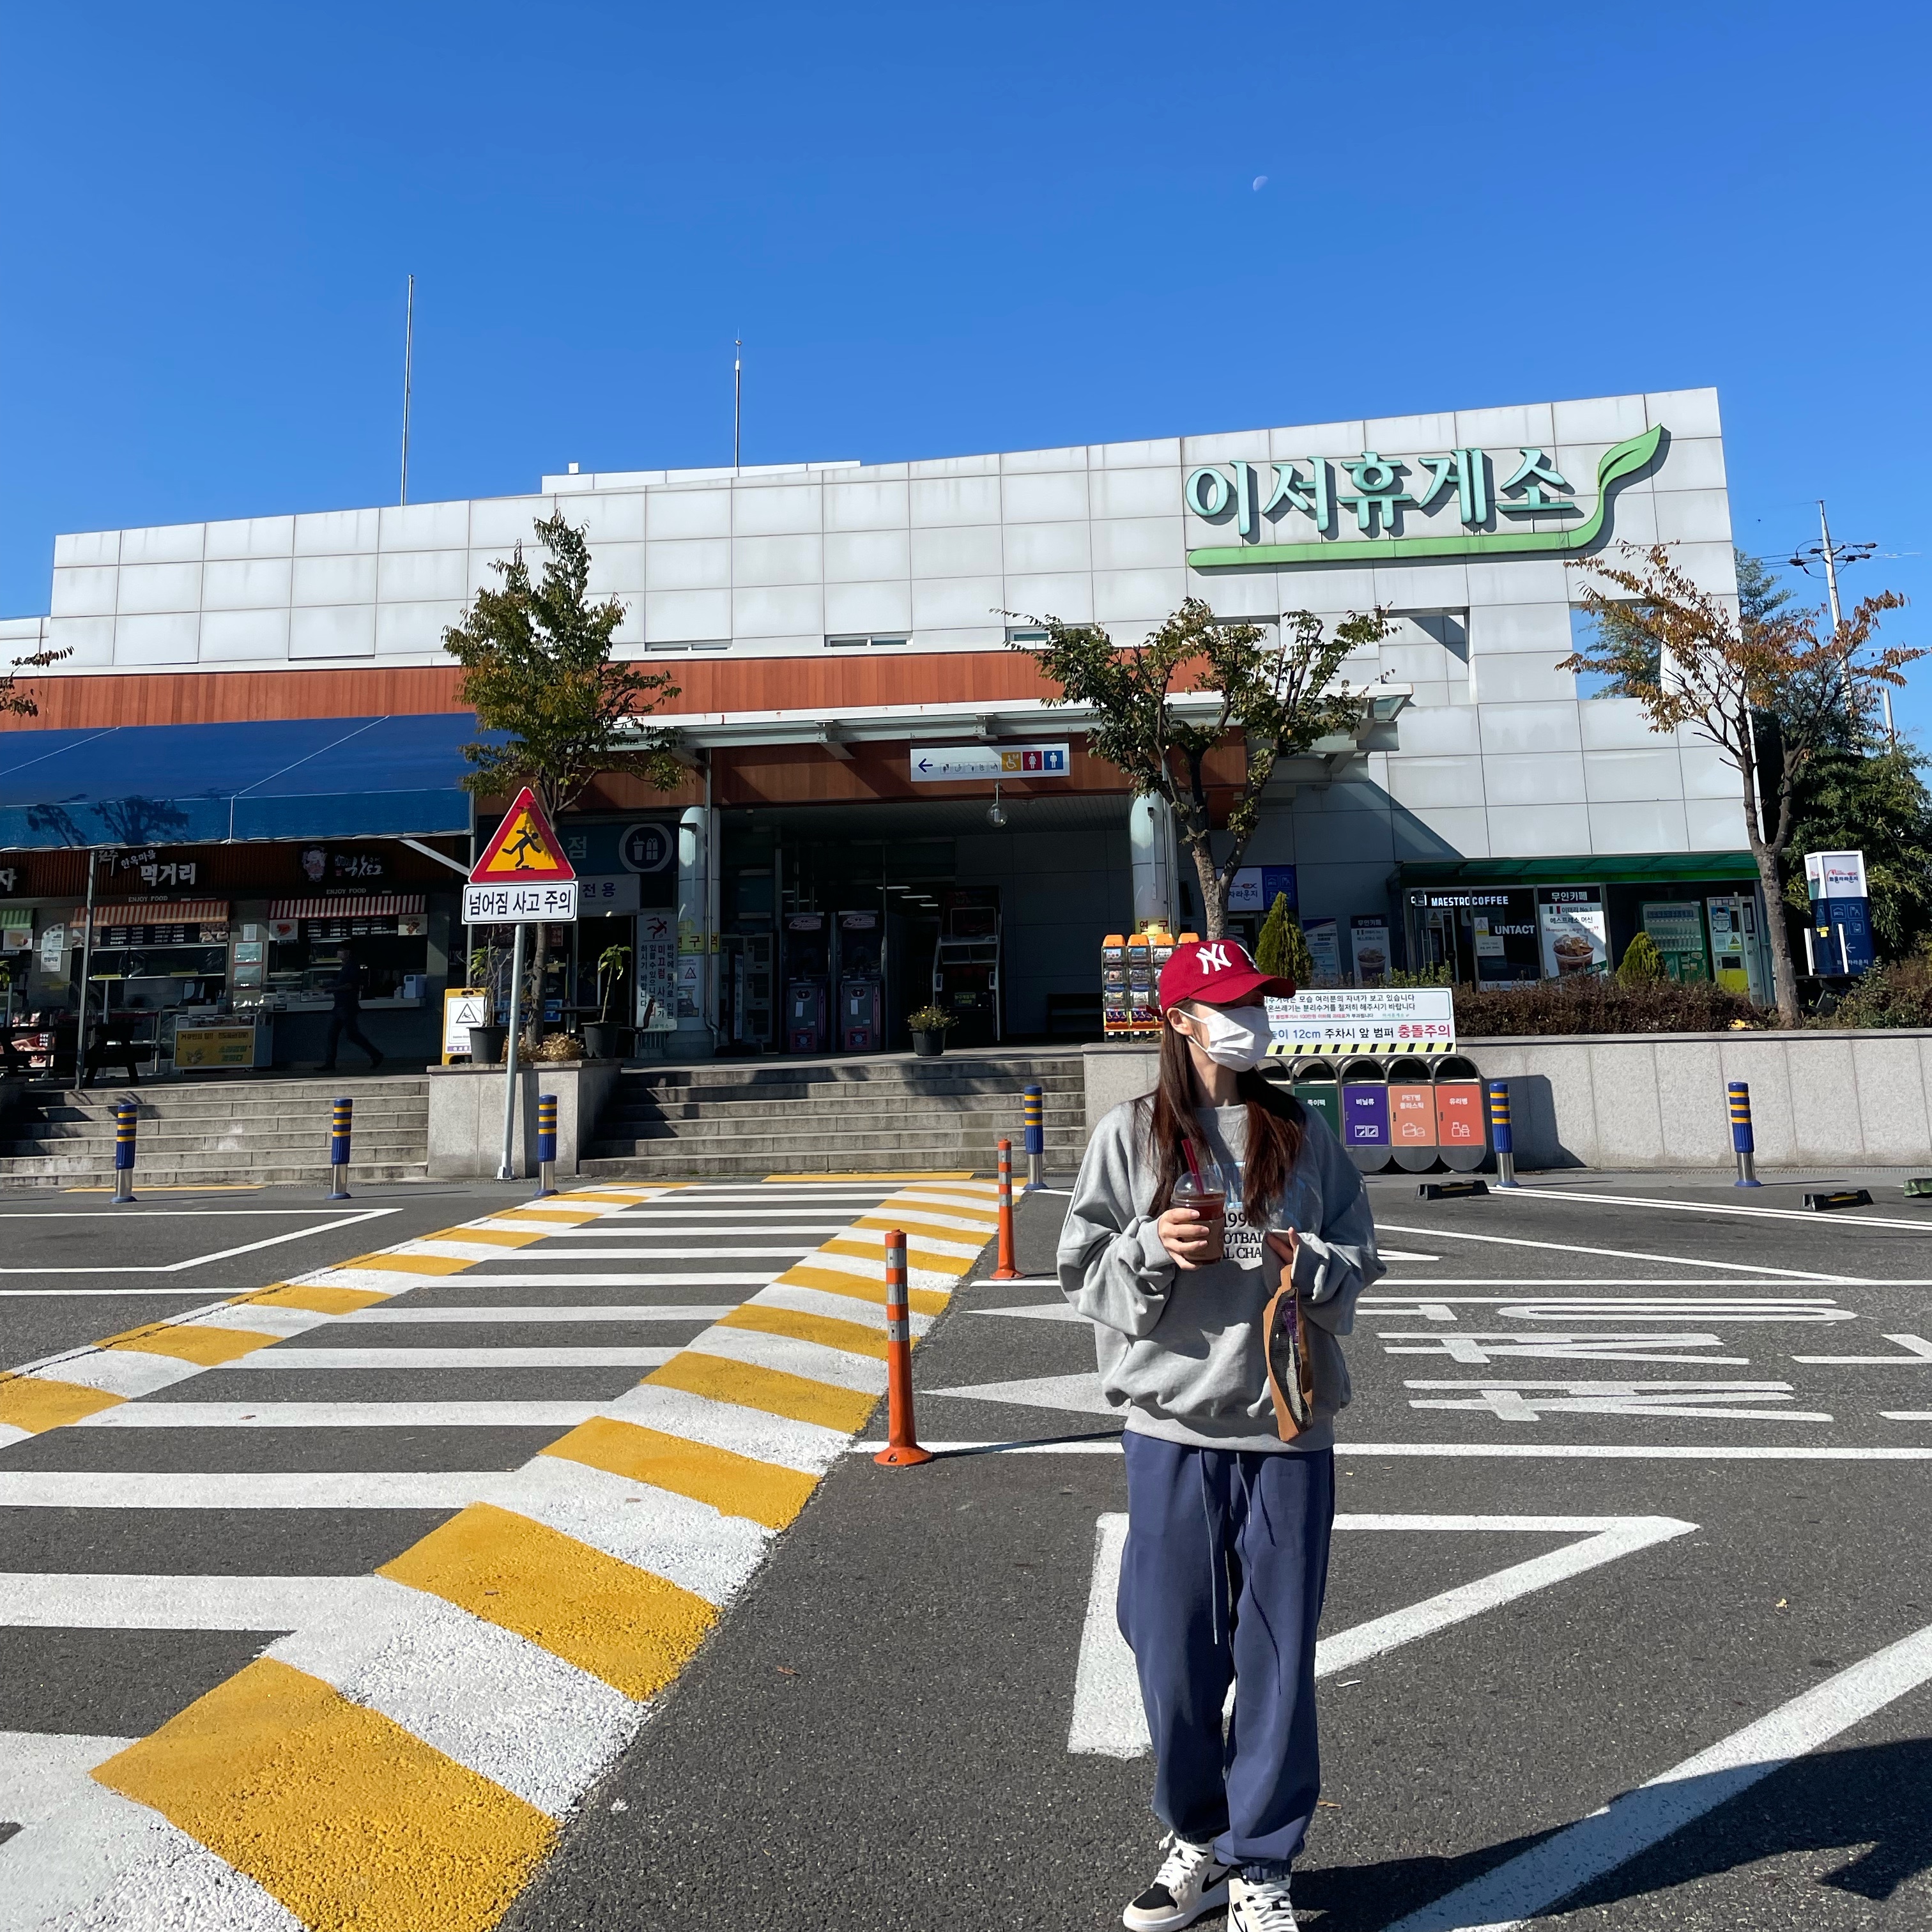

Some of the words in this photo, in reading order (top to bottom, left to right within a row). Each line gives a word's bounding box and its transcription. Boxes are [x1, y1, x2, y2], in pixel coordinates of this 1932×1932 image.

[1185, 448, 1575, 537] 이서휴게소
[141, 863, 195, 886] 먹거리
[470, 891, 508, 916] 넘어짐
[513, 891, 540, 914] 사고
[544, 889, 571, 914] 주의
[1431, 896, 1470, 907] MAESTRO
[1472, 896, 1508, 905] COFFEE
[1551, 891, 1588, 901] 무인카페
[1495, 925, 1535, 934] UNTACT
[1195, 943, 1232, 975] NY
[1360, 1003, 1387, 1011] 해주시기
[1292, 1029, 1321, 1039] 12cm
[1324, 1028, 1356, 1039] 주차시
[1360, 1028, 1370, 1038] 앞
[1374, 1027, 1394, 1038] 범퍼
[1398, 1024, 1451, 1038] 충돌주의
[1224, 1213, 1254, 1228] 199
